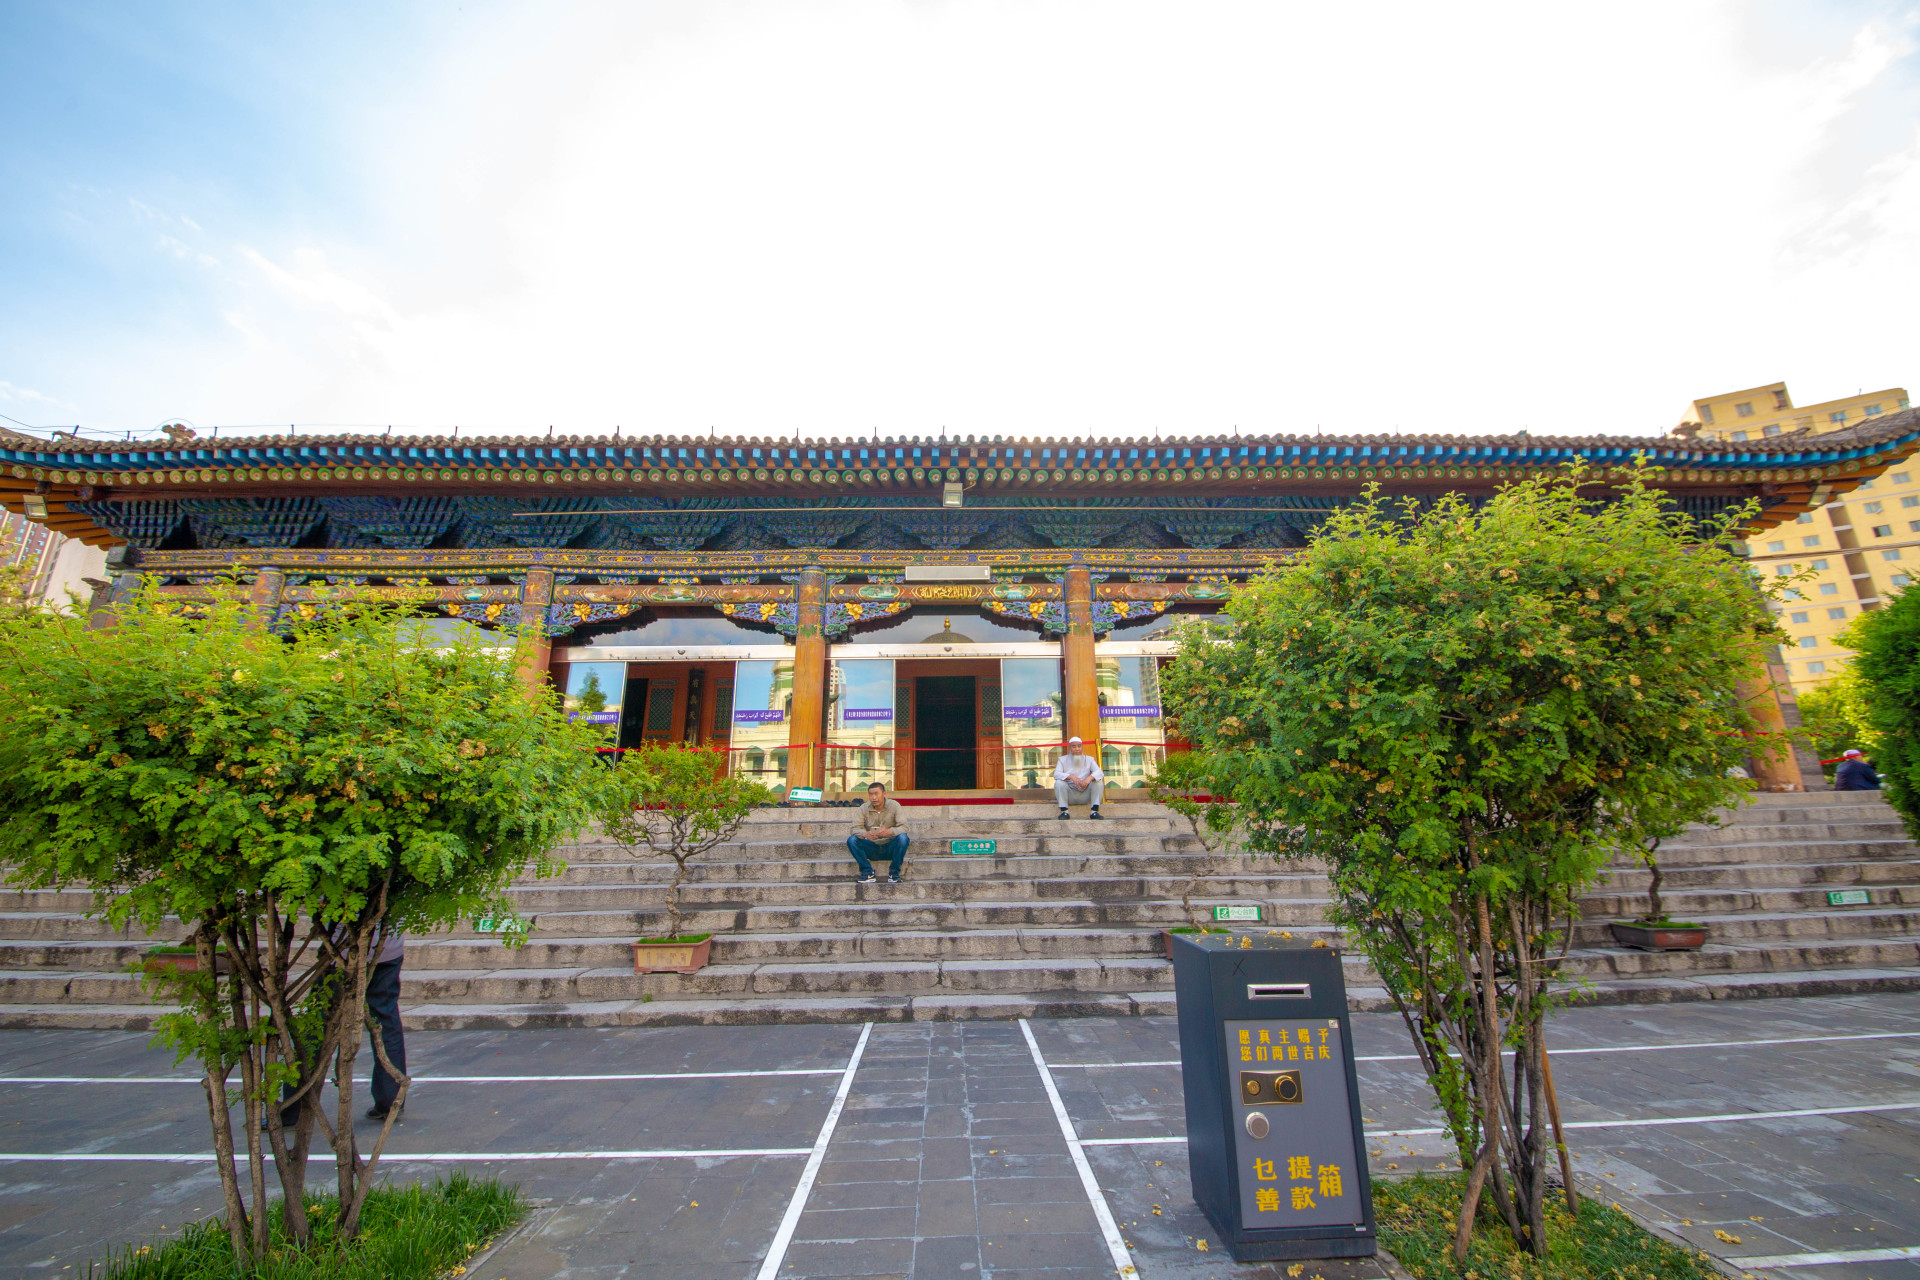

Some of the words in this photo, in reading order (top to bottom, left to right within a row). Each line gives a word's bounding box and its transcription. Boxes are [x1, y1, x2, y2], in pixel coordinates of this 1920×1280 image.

[1230, 908, 1255, 916] 小心台阶
[1240, 1045, 1331, 1061] 您们两世吉庆
[1317, 1164, 1343, 1197] 箱
[1255, 1186, 1317, 1212] 善款
